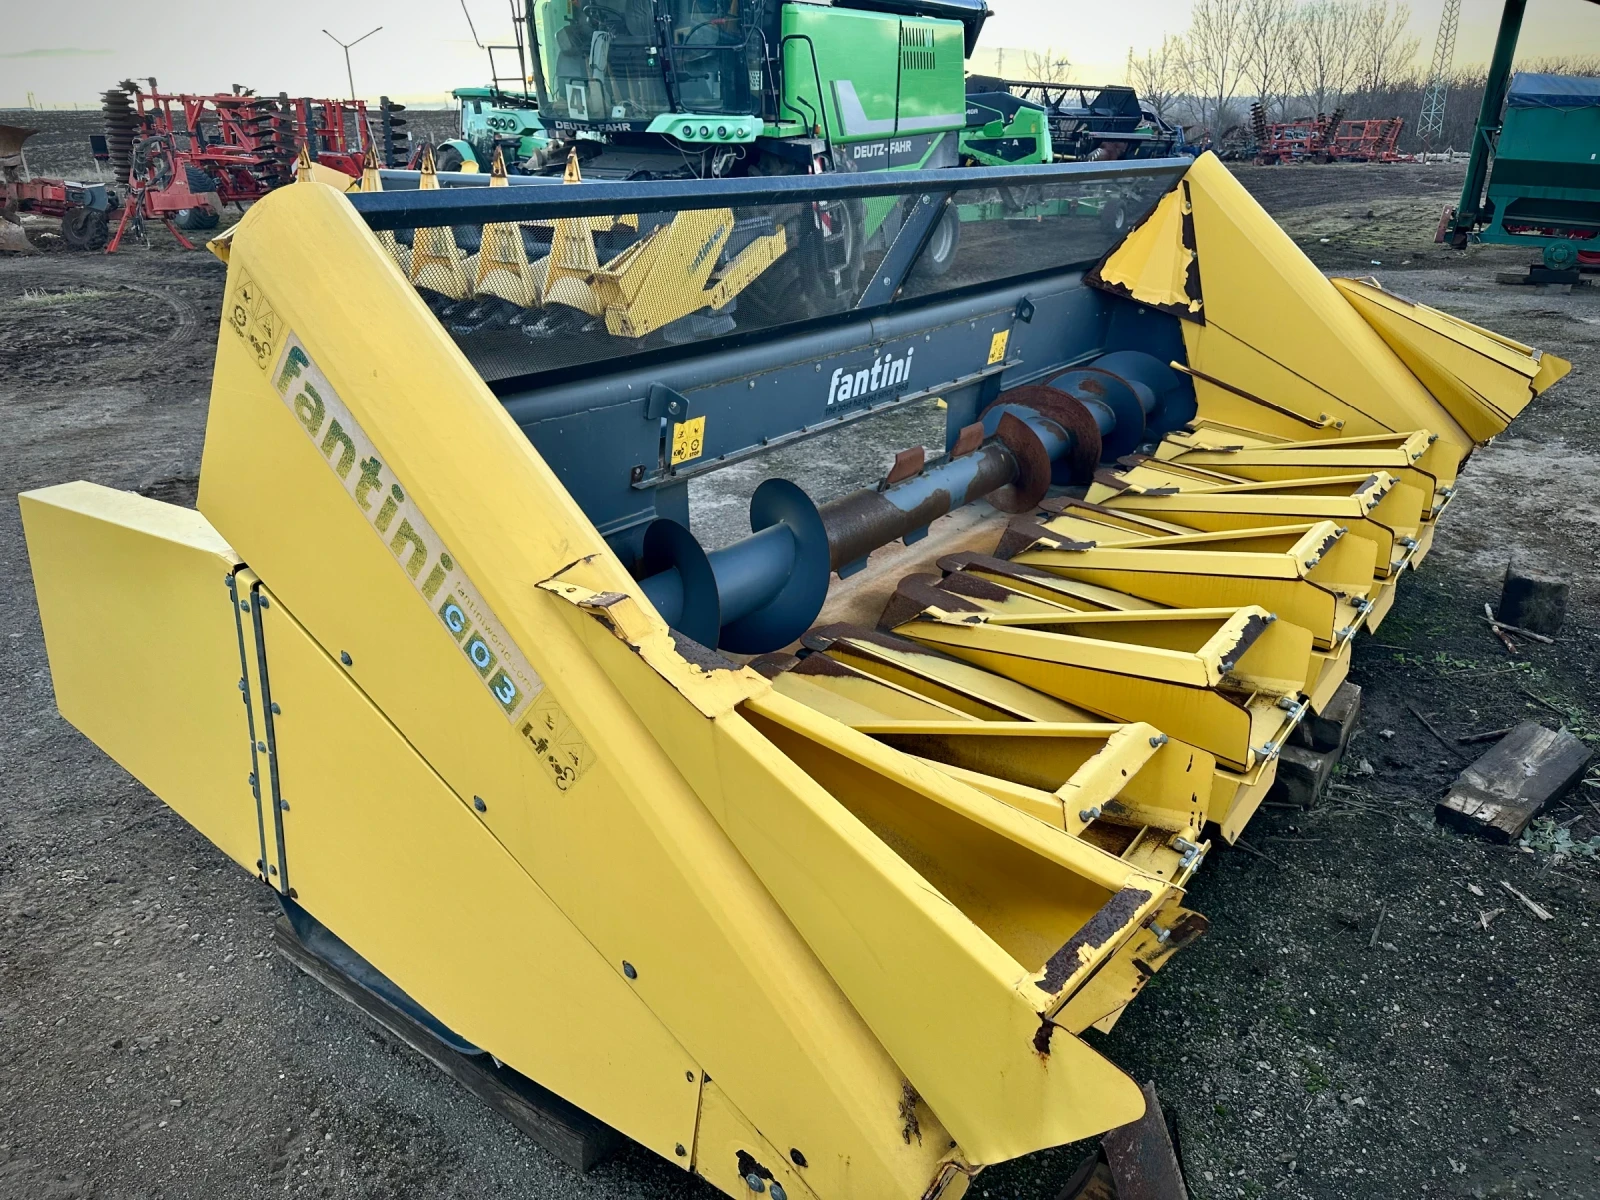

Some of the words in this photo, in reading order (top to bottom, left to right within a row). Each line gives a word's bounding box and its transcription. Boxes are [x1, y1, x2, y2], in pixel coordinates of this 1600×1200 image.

[570, 87, 586, 115] 4
[554, 120, 632, 132] DEUTZ-FAHR
[853, 140, 912, 159] DEUTZ-FAHR
[827, 346, 915, 406] fantini
[276, 344, 454, 603] fantini
